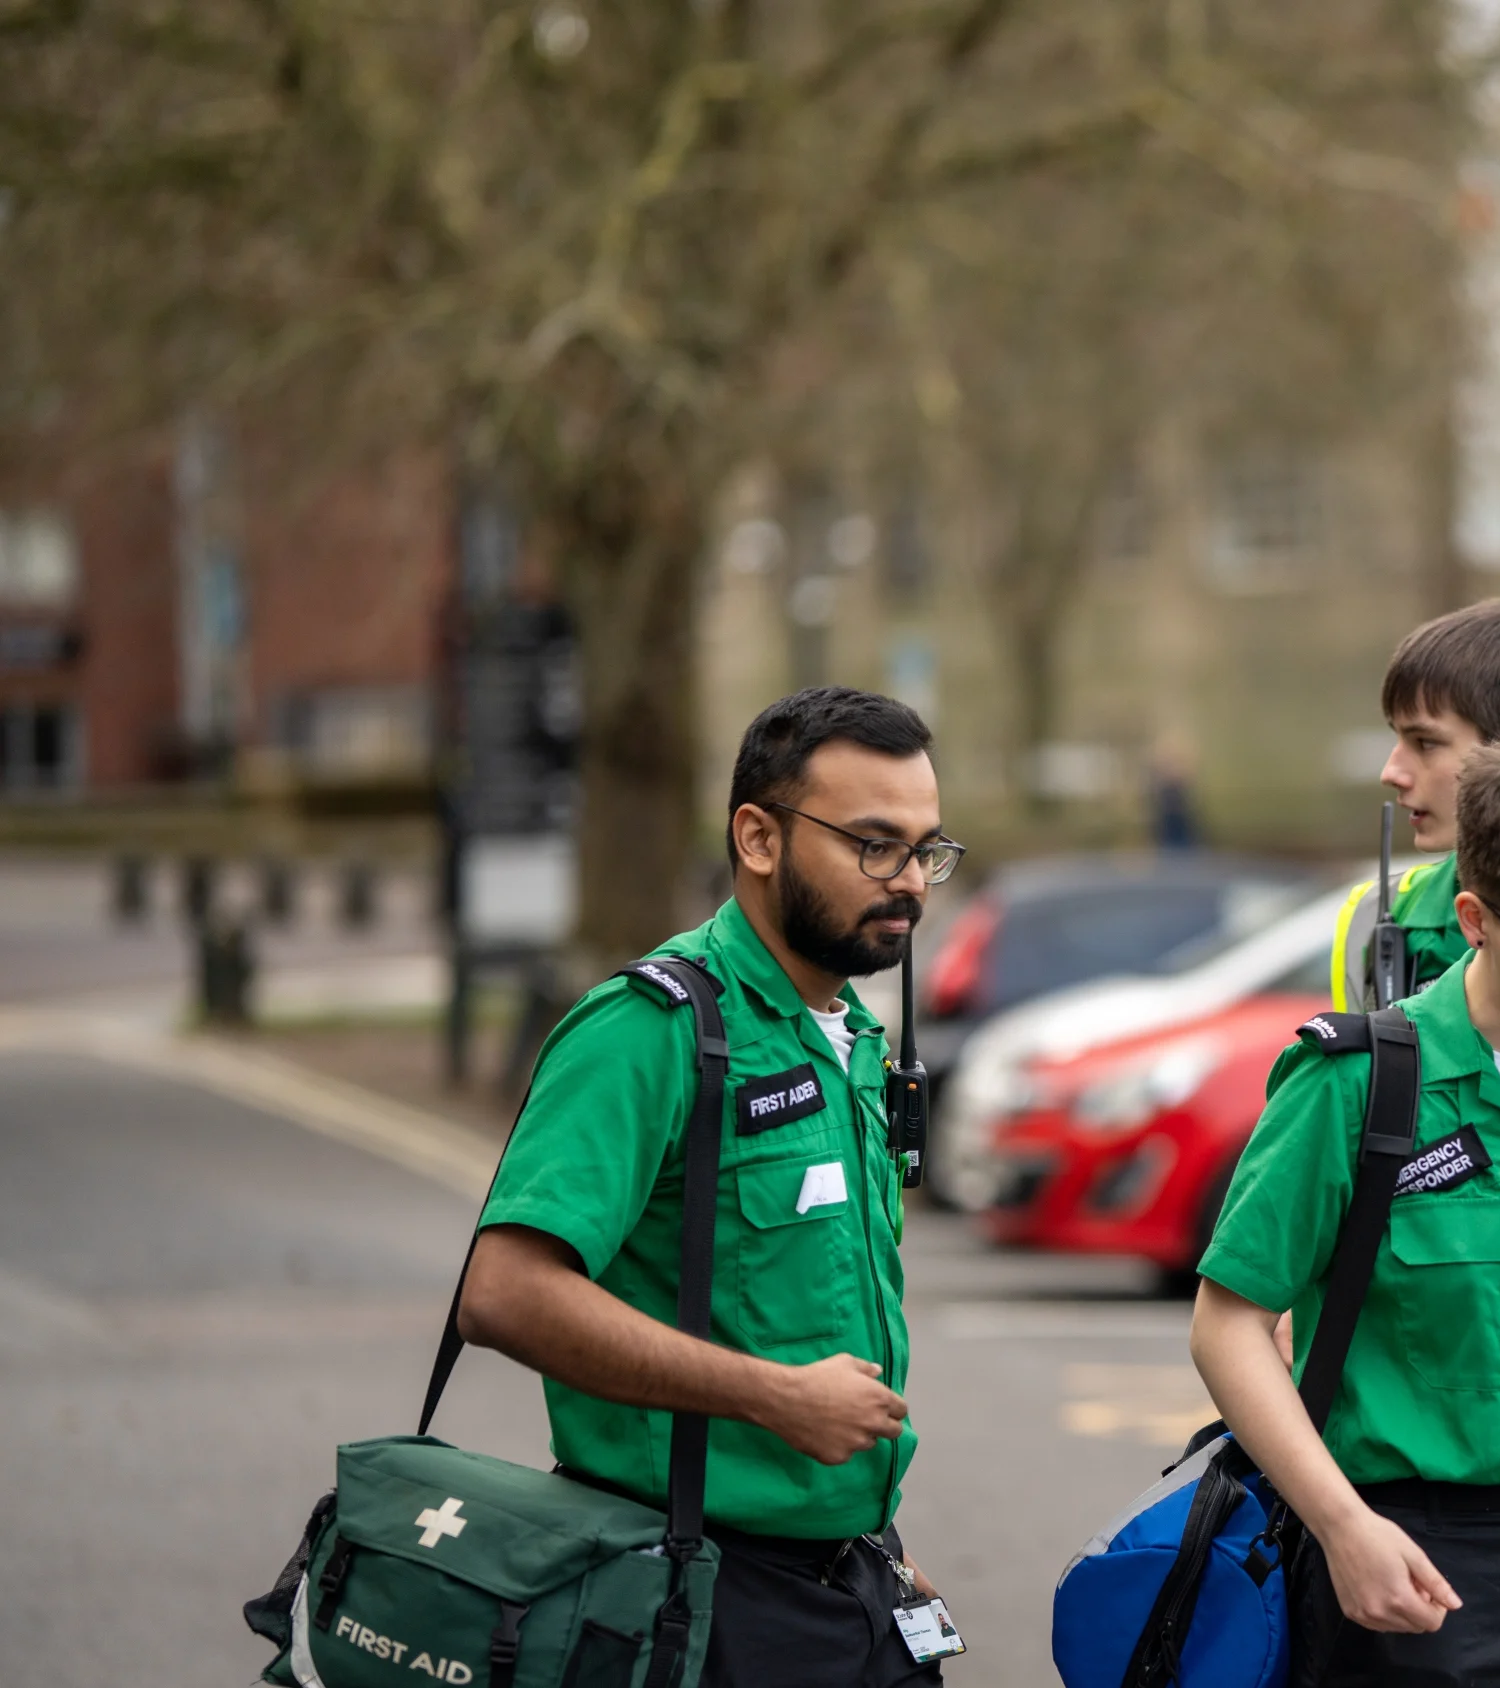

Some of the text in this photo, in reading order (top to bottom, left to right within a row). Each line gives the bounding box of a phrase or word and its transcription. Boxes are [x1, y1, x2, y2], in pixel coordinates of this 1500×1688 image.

[749, 1080, 818, 1118] FIRST AIDER
[1395, 1137, 1464, 1188] MERGENCY
[335, 1615, 474, 1686] FIRST AID
